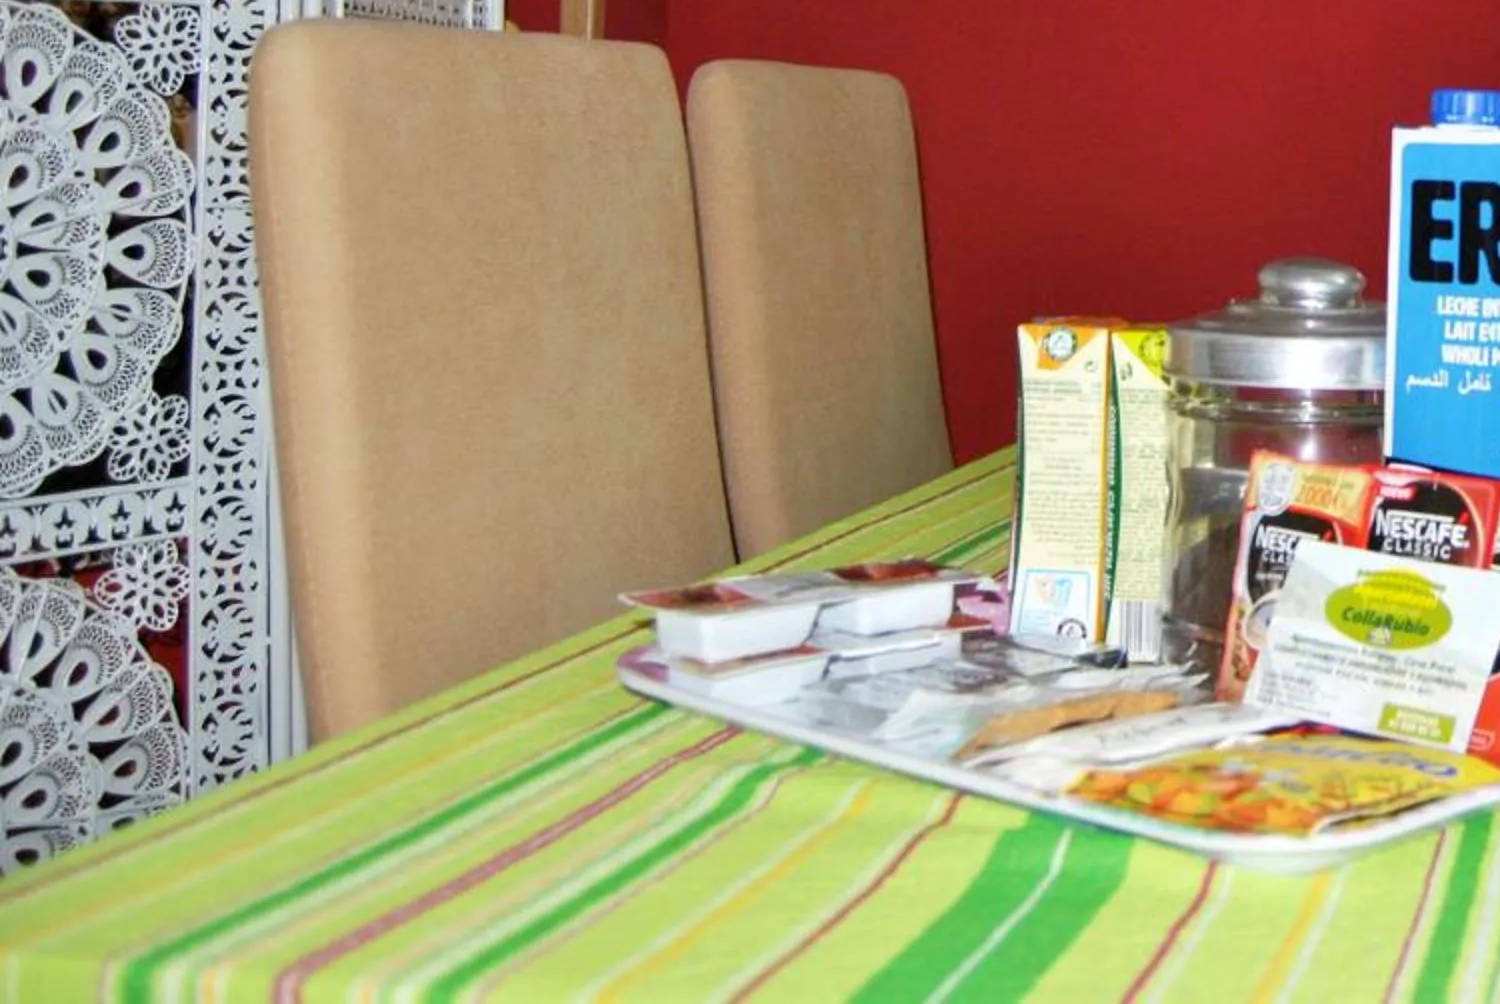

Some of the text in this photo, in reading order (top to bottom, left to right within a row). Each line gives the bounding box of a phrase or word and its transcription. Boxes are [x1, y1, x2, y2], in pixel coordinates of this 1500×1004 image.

[1444, 320, 1477, 340] LAIT
[1256, 524, 1300, 552] NESC
[1383, 537, 1452, 560] CLASSIC
